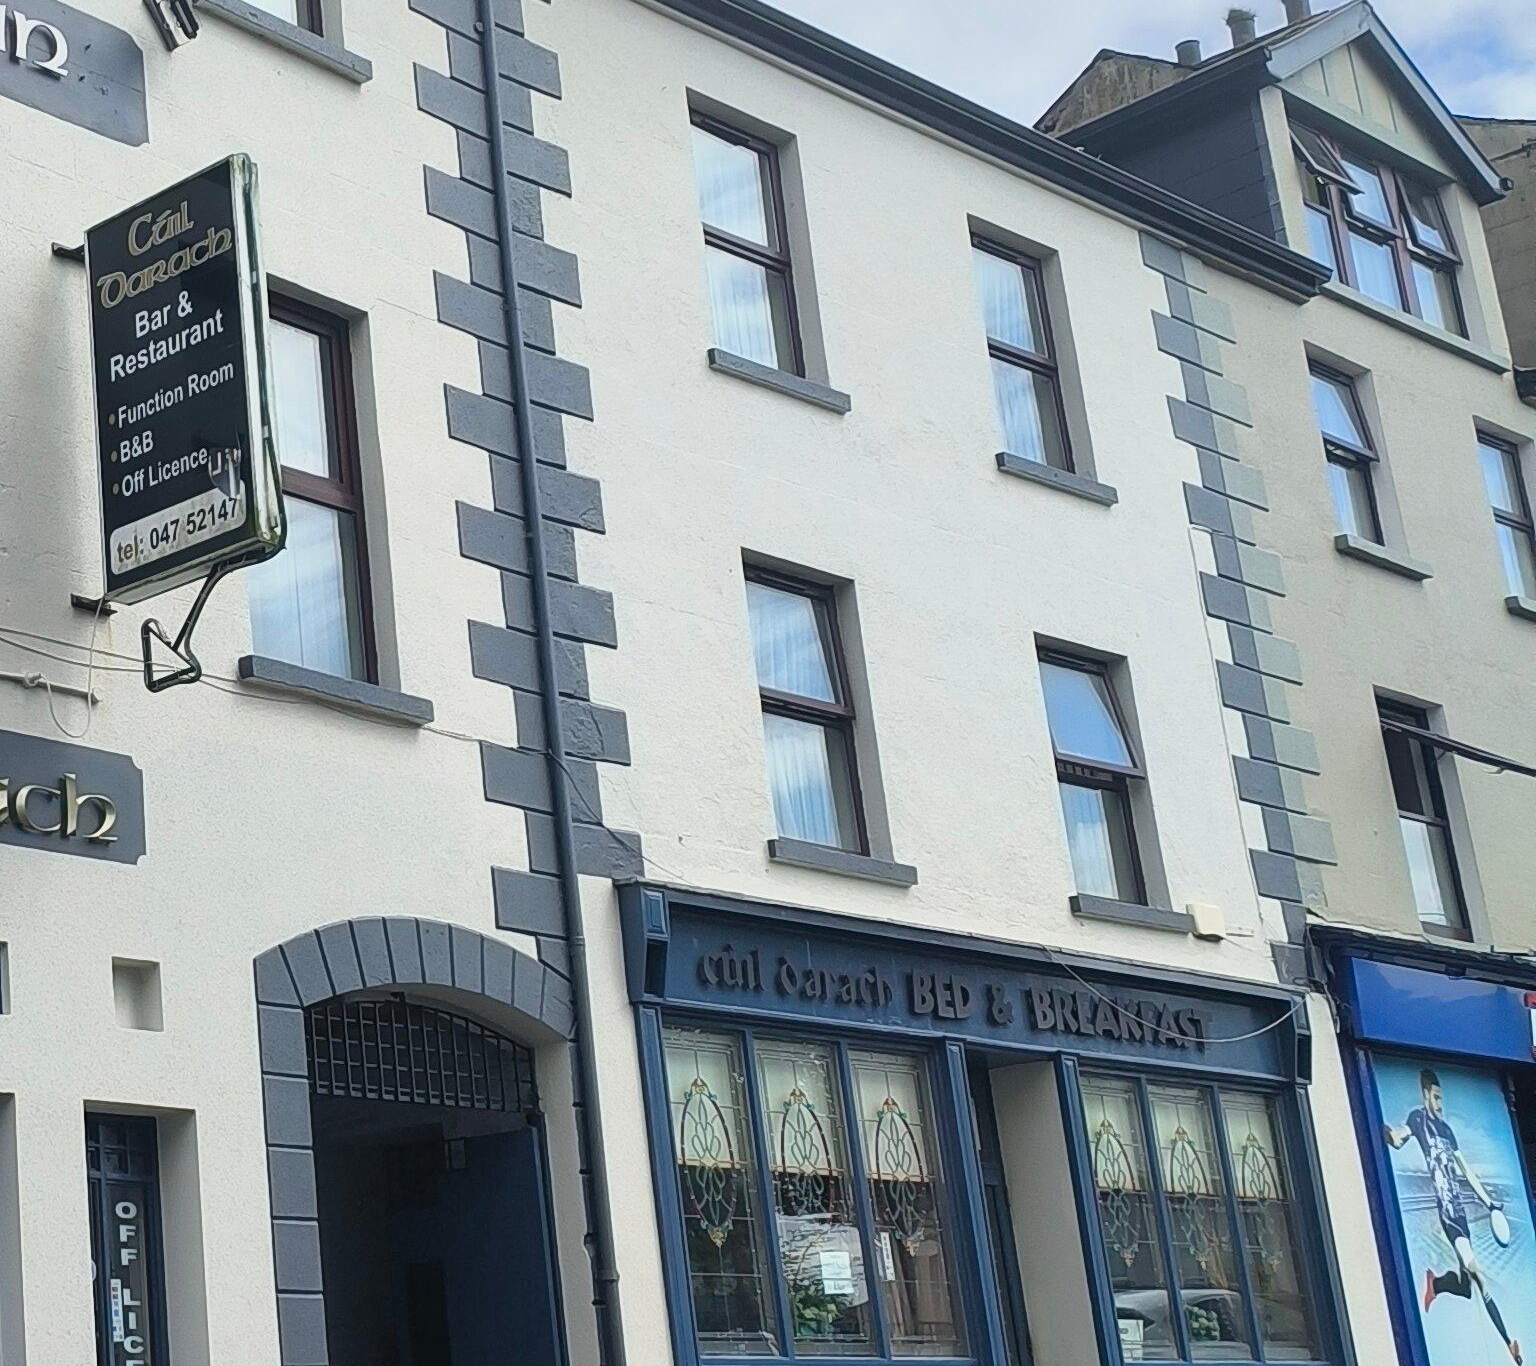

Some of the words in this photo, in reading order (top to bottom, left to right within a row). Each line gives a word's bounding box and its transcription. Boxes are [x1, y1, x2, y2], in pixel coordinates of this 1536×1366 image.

[96, 227, 233, 308] Darach
[110, 308, 224, 382] Restaurant
[135, 304, 171, 338] Bar
[177, 290, 193, 317] &
[118, 386, 184, 428] Function
[187, 362, 234, 397] Room
[120, 430, 154, 463] B&B
[121, 468, 145, 496] Off
[148, 448, 208, 487] Licence
[117, 534, 144, 563] tel:
[149, 518, 180, 550] 047
[186, 498, 238, 535] 52147
[913, 969, 972, 1020] BED
[990, 984, 1014, 1027] &
[1032, 986, 1211, 1054] BREAKFAST
[114, 1201, 138, 1266] OFF
